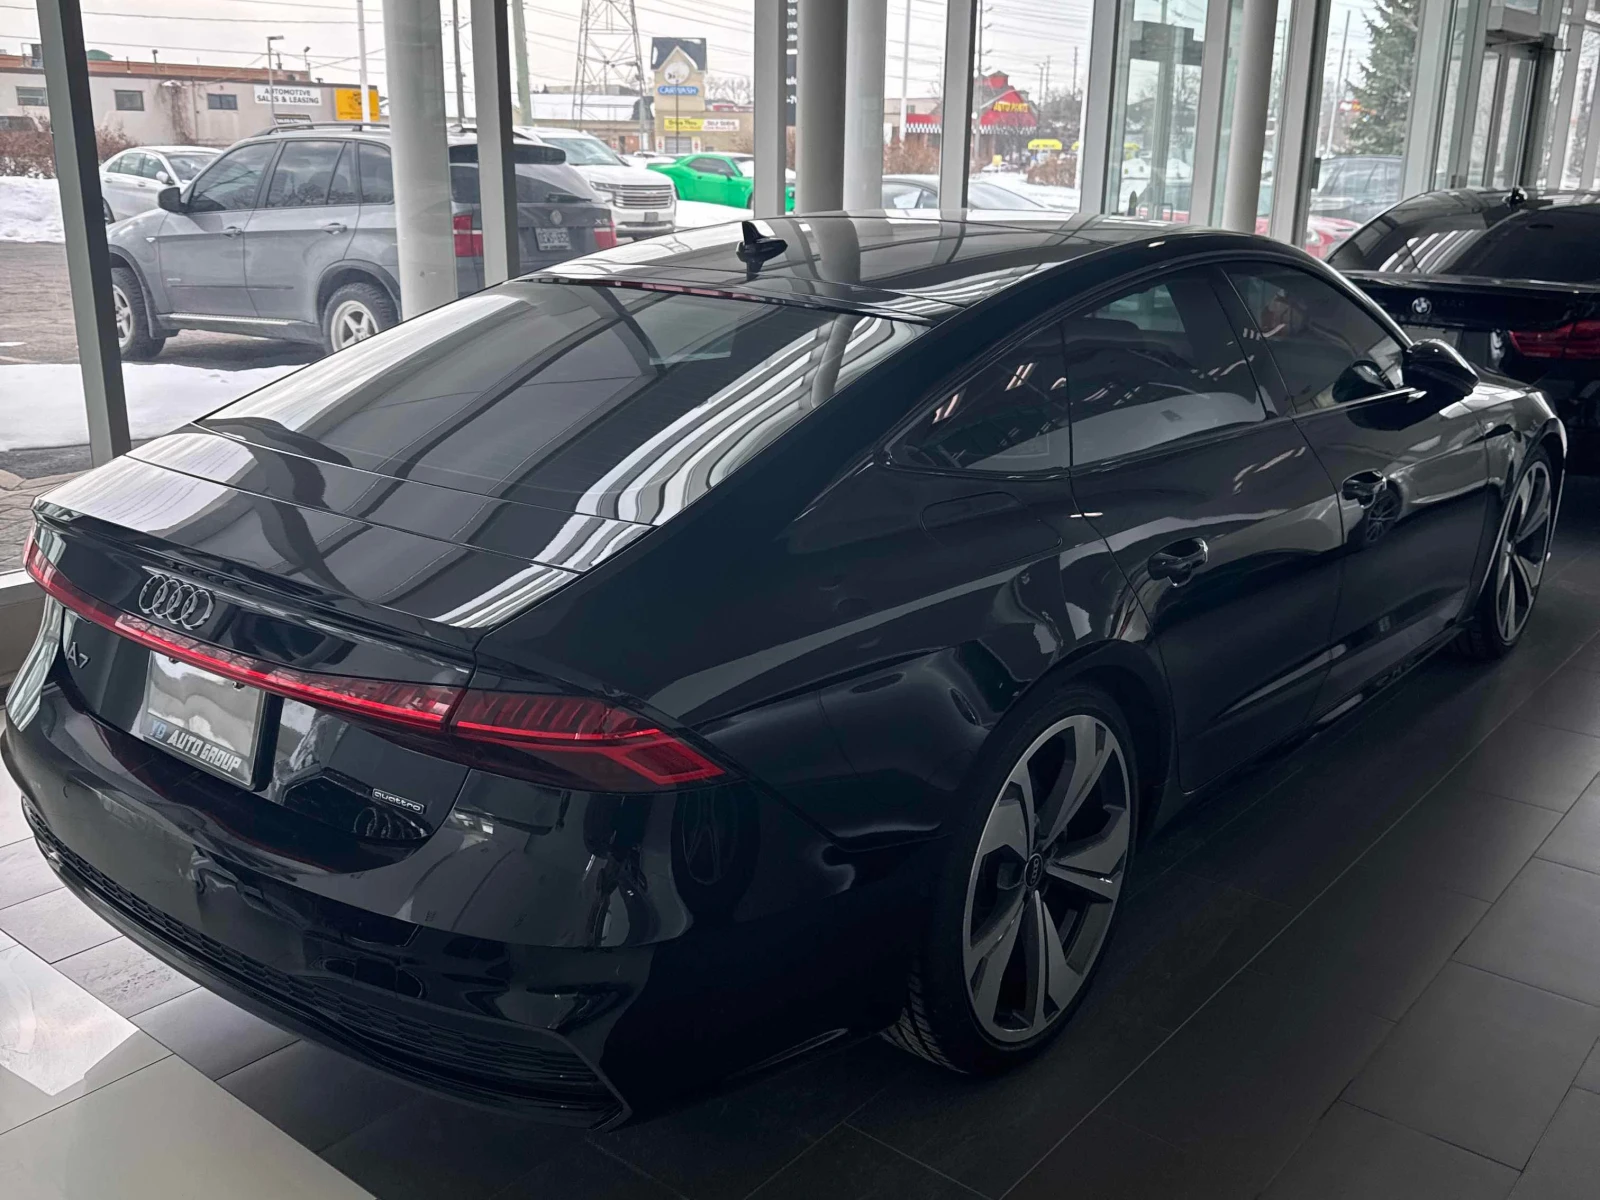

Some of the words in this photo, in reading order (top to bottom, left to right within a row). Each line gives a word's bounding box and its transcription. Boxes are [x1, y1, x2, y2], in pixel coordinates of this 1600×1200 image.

[66, 641, 89, 669] A7
[166, 729, 204, 757] AUTO
[199, 743, 243, 772] GROUP
[374, 790, 421, 811] quattro
